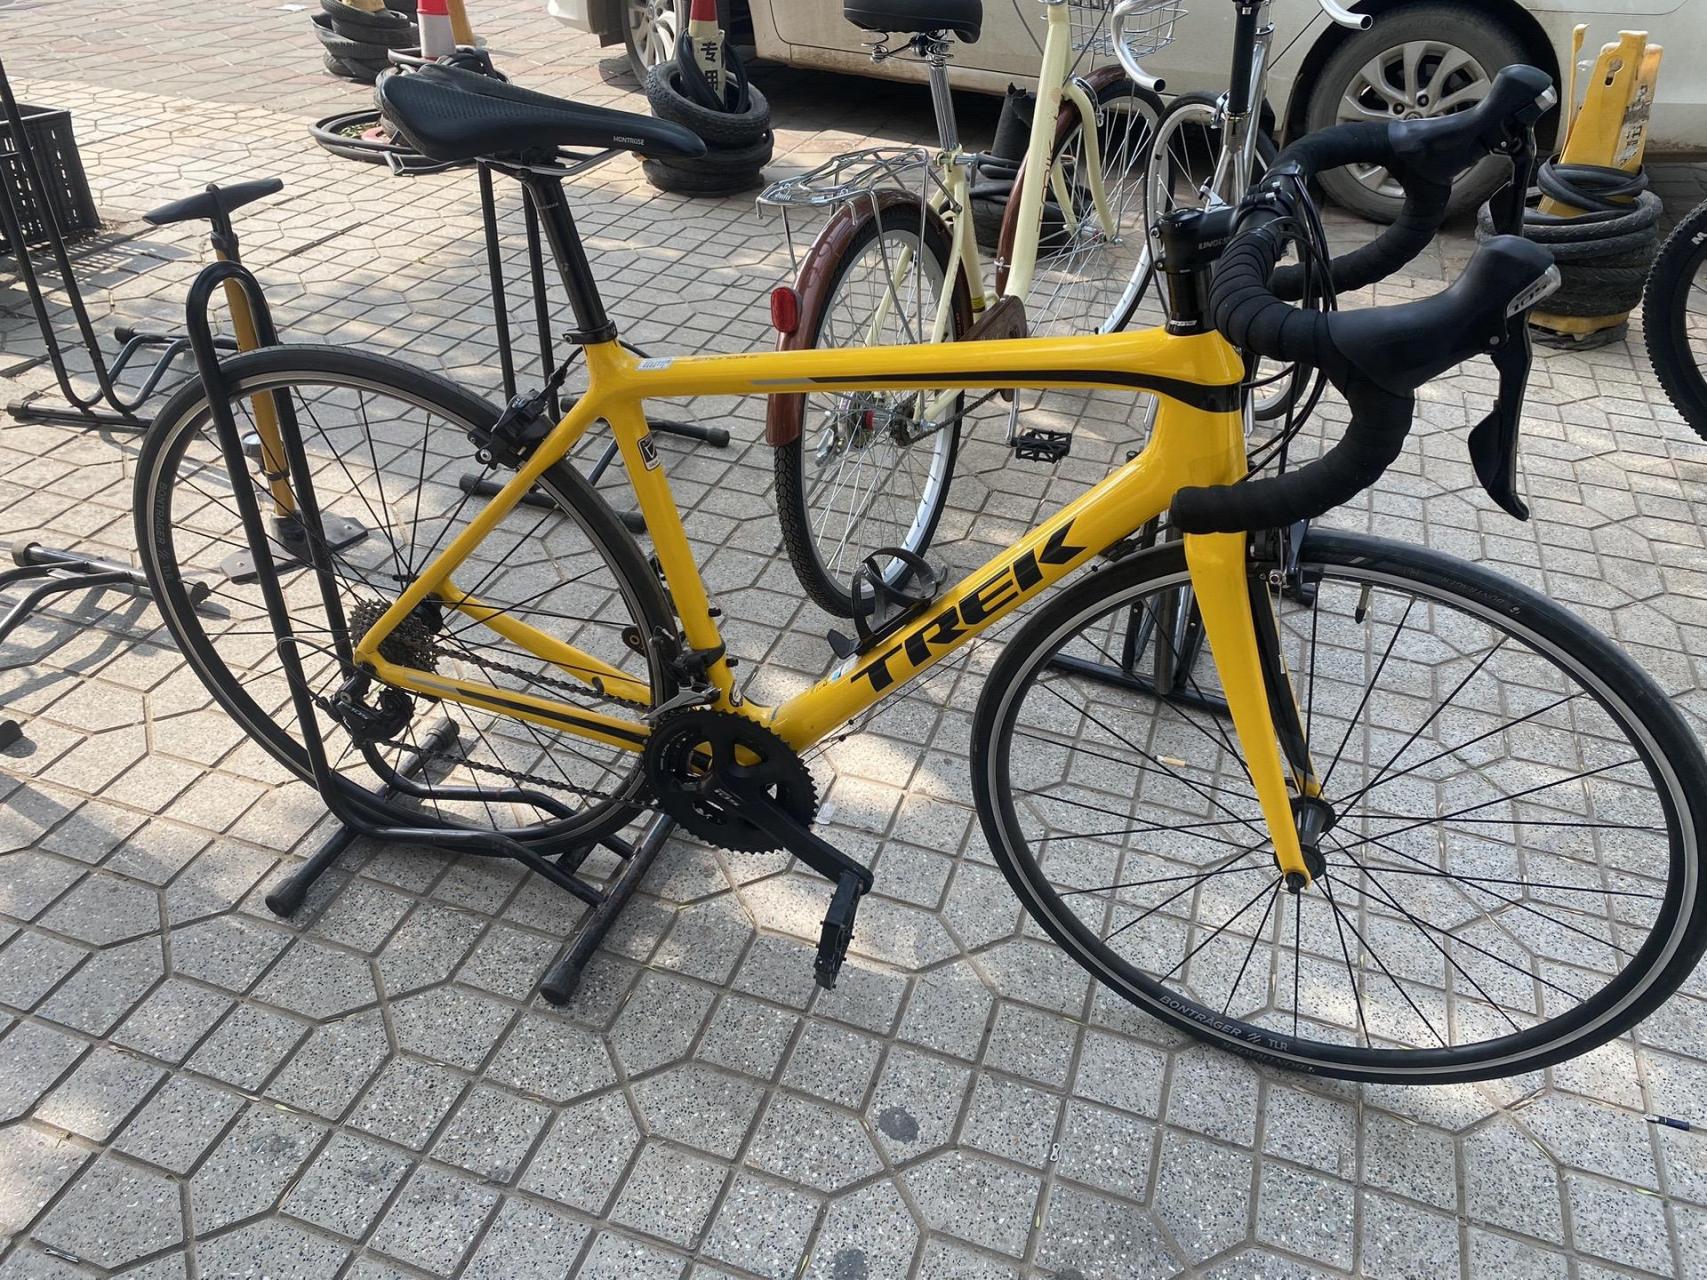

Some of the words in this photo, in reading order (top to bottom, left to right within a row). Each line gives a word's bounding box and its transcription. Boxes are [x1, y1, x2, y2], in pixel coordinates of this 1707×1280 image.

[850, 517, 1088, 693] TREK
[1158, 995, 1243, 1037] BONTRAGER
[1267, 1037, 1289, 1051] TLR
